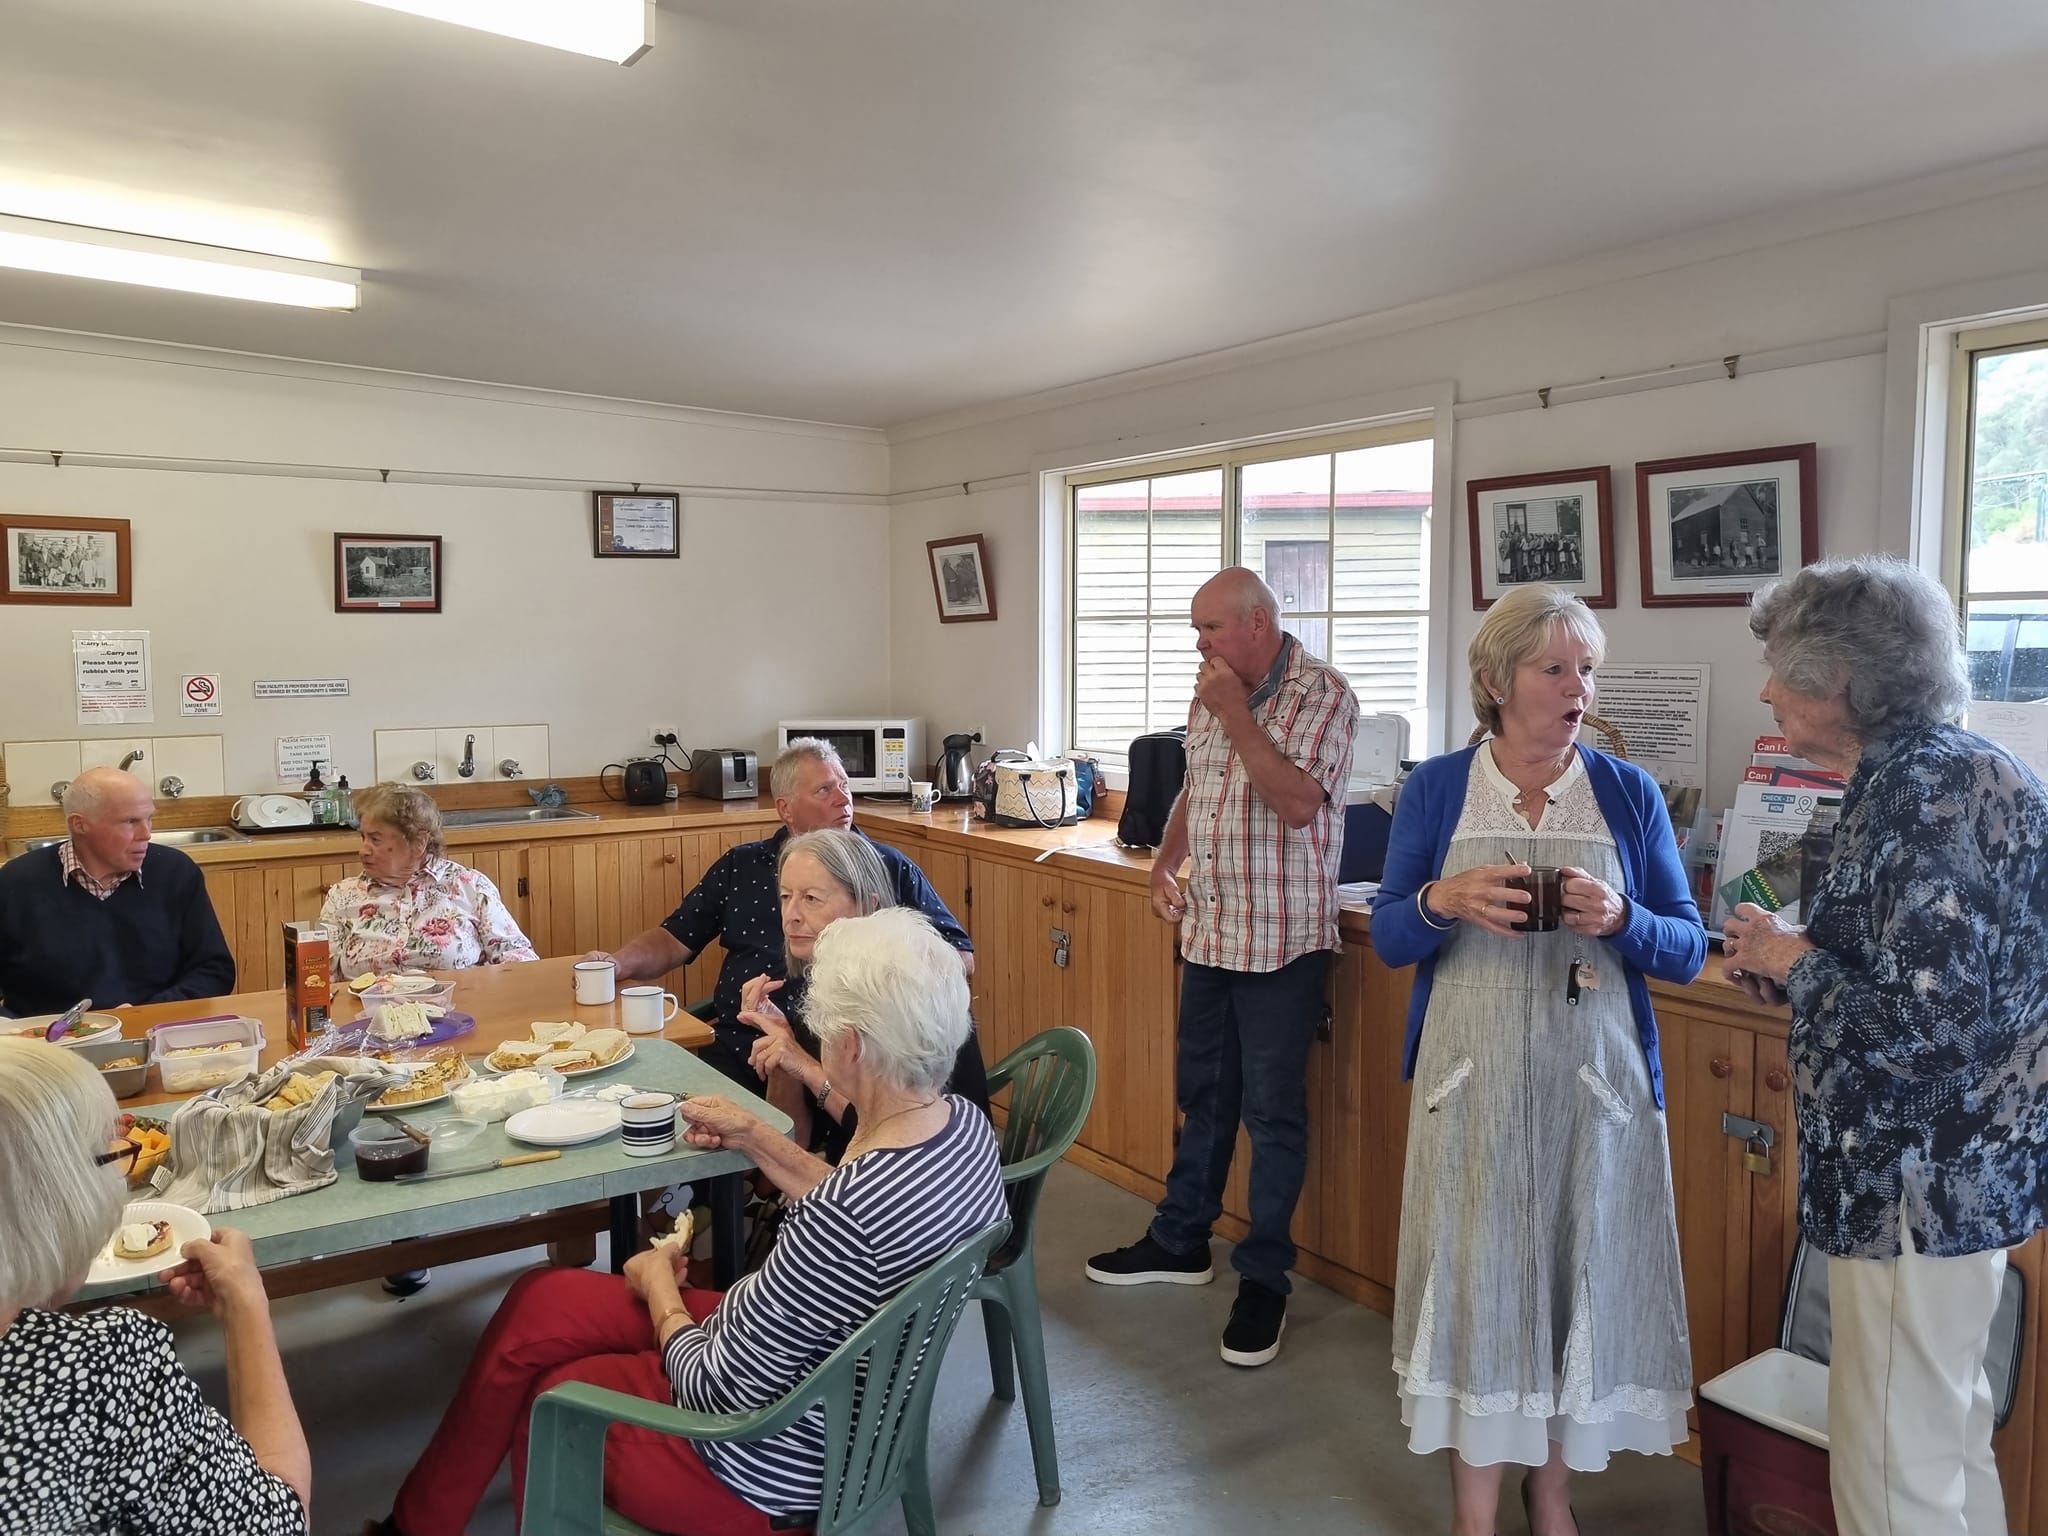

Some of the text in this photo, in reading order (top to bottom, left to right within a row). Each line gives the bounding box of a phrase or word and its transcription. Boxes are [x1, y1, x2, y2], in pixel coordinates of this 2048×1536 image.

[1757, 743, 1775, 751] Can
[1778, 744, 1781, 752] I
[1748, 771, 1767, 779] Can
